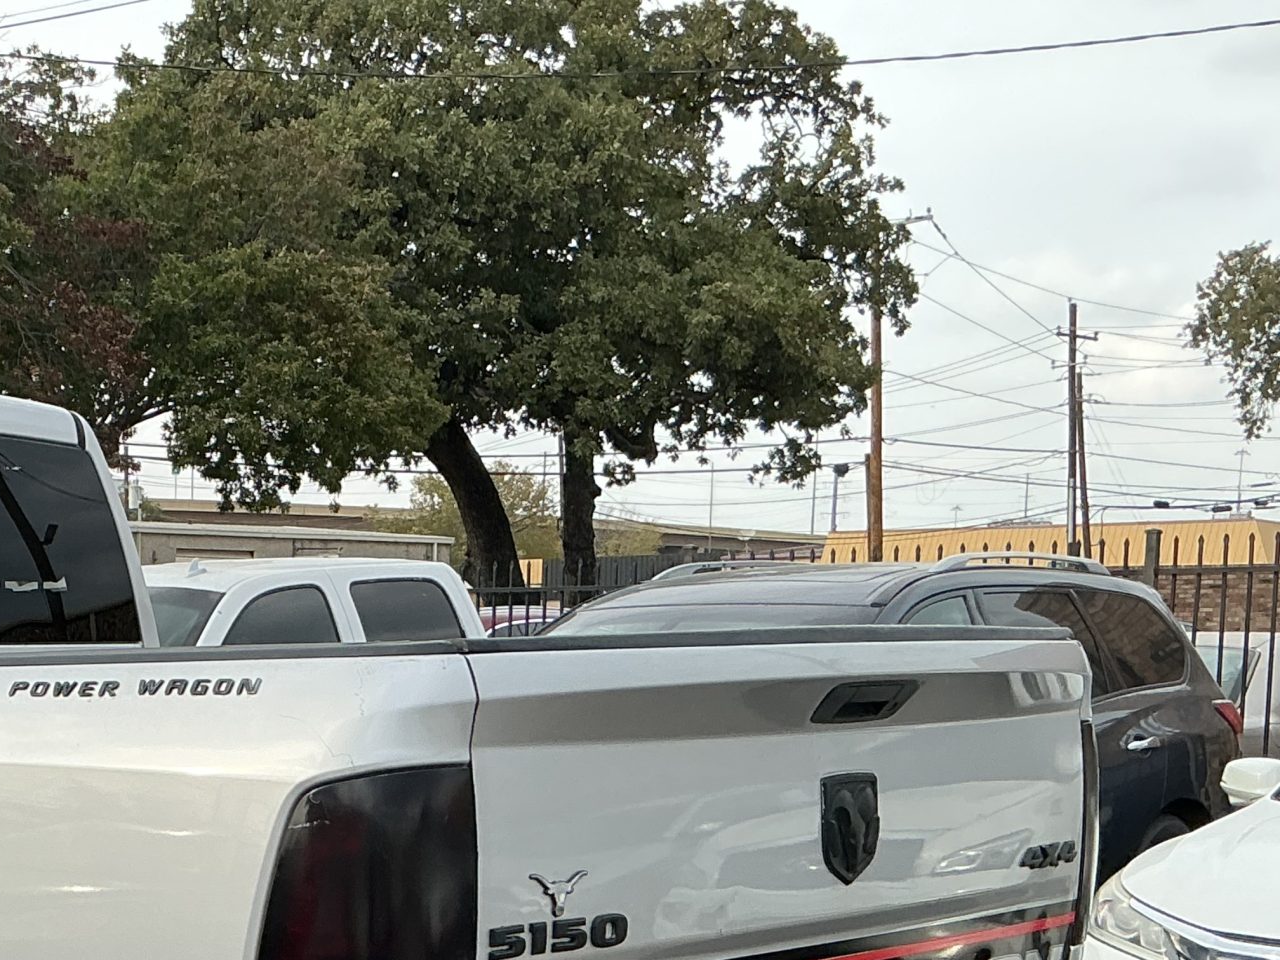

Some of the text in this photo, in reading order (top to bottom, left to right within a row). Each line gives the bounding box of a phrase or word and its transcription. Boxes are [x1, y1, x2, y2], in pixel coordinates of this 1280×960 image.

[8, 677, 262, 698] POWER WAGON
[1018, 840, 1077, 869] 4X4
[488, 913, 628, 960] 5150
